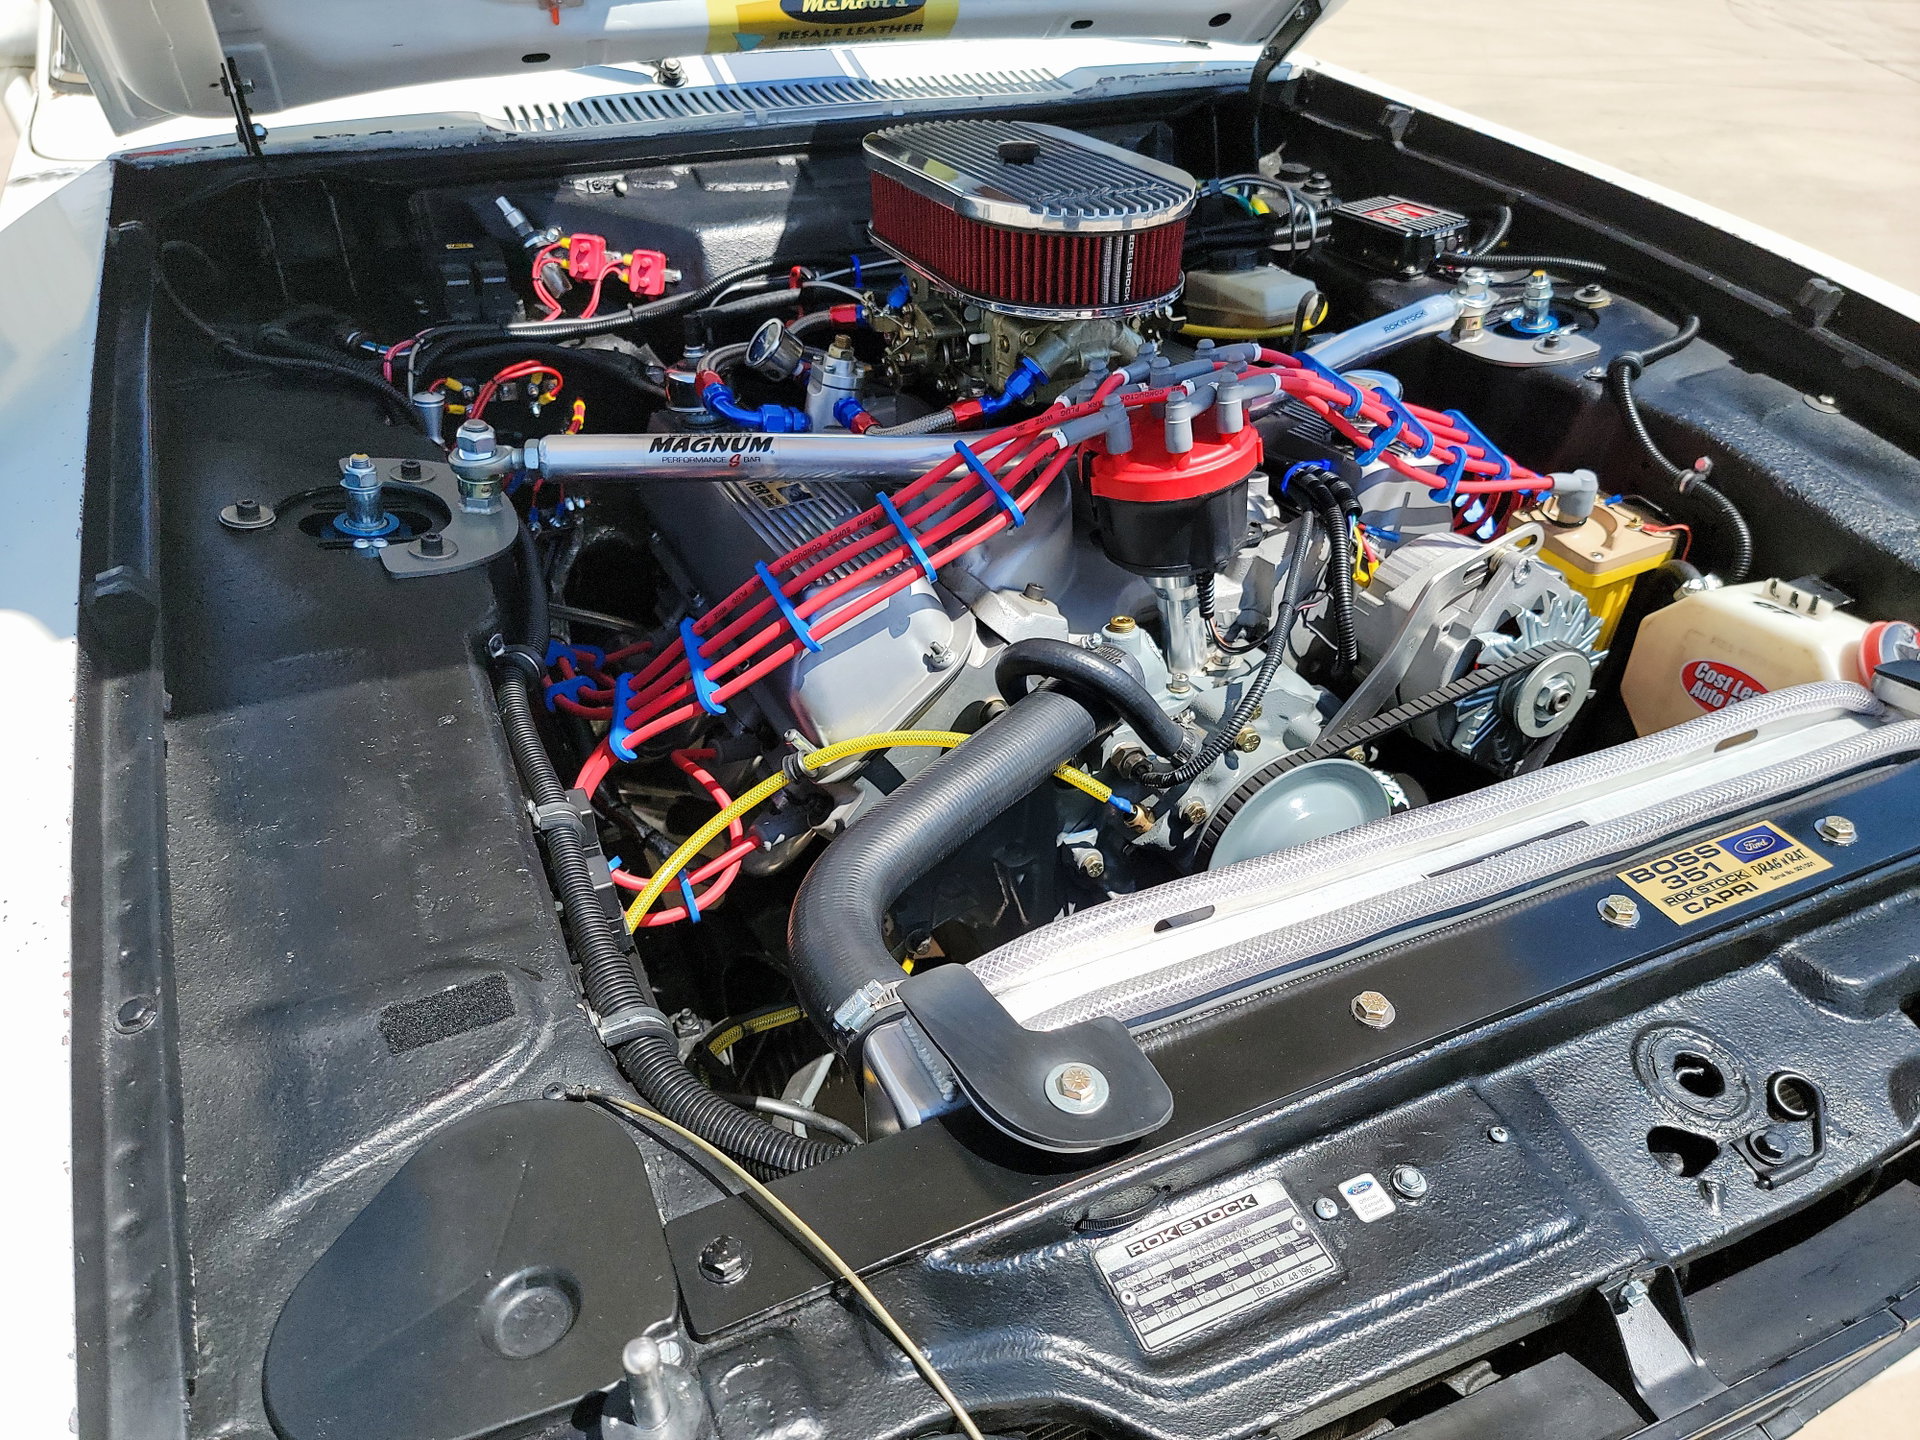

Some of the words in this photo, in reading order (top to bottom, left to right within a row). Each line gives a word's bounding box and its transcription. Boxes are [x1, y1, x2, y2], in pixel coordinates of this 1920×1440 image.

[778, 28, 843, 40] RESALE
[846, 24, 924, 37] LEATHER
[1124, 234, 1136, 302] EDELBROCK
[649, 436, 774, 453] MAGNUM
[661, 456, 726, 464] PERFORMANCE
[729, 453, 742, 467] S
[779, 542, 822, 570] CONDUCTOR
[1694, 662, 1734, 692] Cost
[1690, 680, 1725, 708] Auto
[1743, 838, 1769, 850] Ford
[1626, 844, 1721, 884] BOSS
[1661, 861, 1723, 890] 351
[1683, 881, 1759, 915] CAPRI
